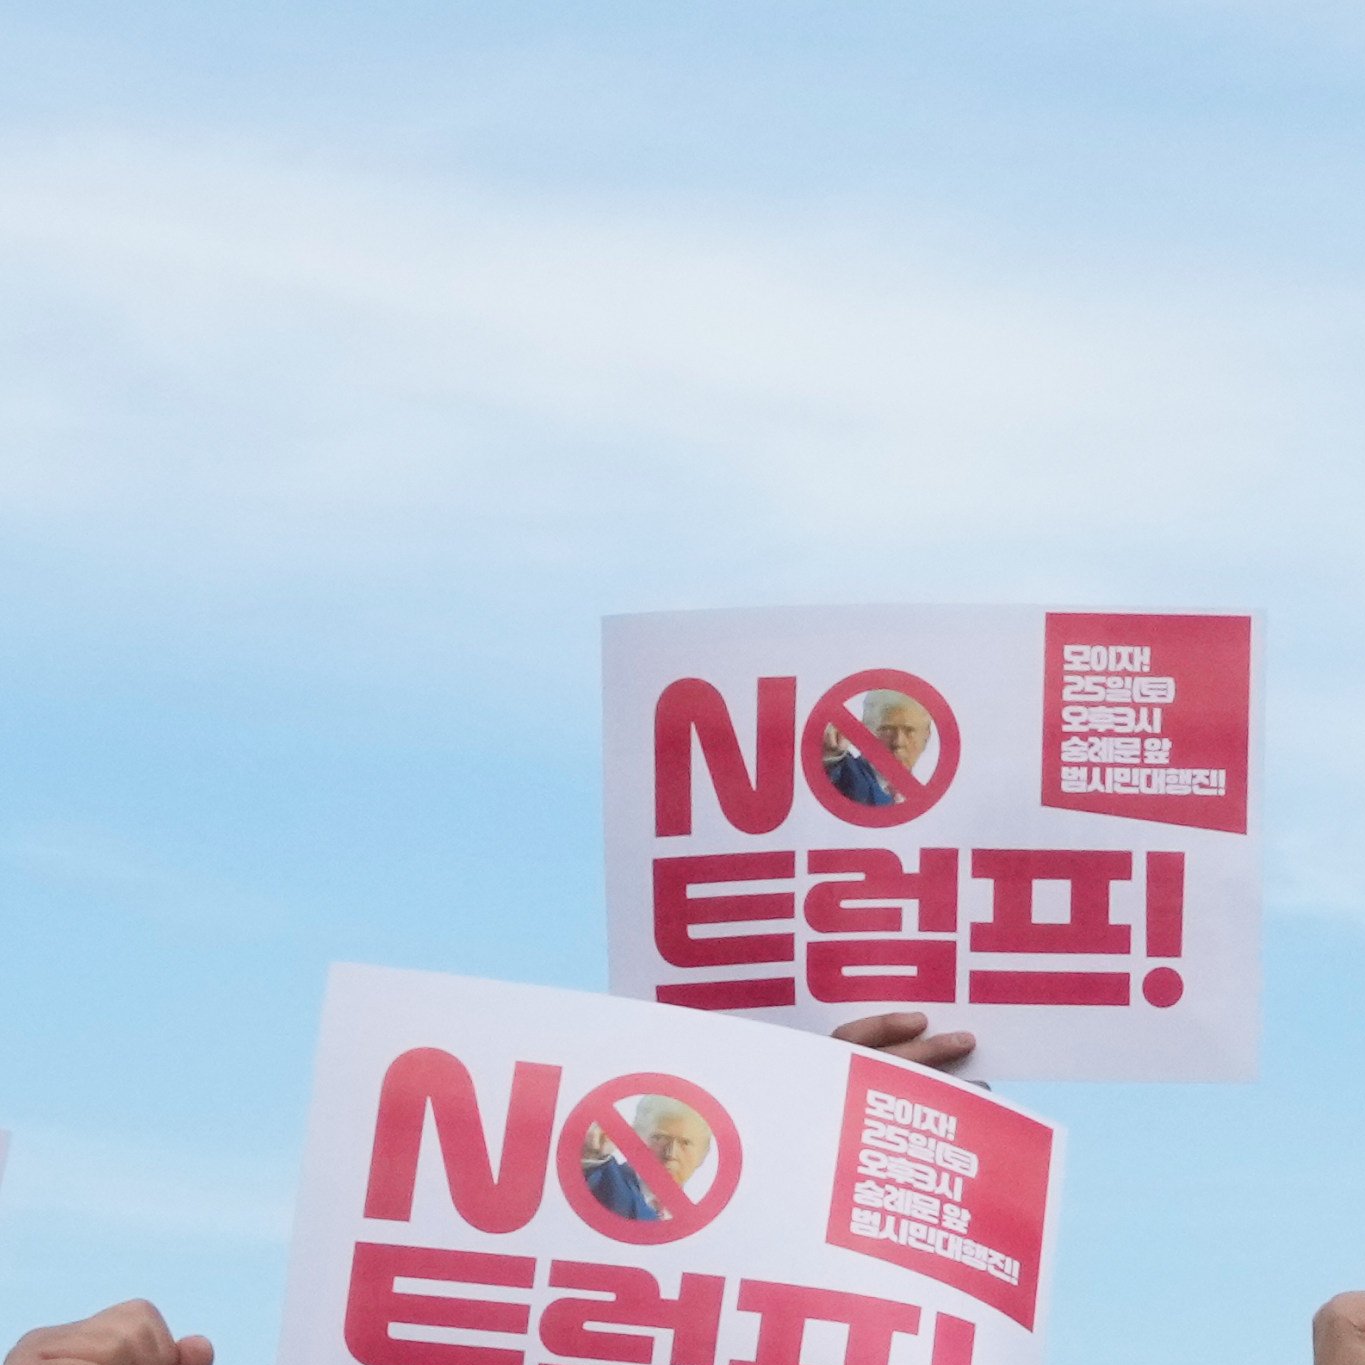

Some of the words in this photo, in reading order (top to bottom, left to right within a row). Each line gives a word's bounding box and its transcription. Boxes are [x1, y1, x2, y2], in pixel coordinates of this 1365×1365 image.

[1064, 645, 1150, 672] 모이자!
[1062, 675, 1176, 704] 25일(토)
[654, 668, 961, 837] NO
[1061, 737, 1142, 764] 숭례문
[1144, 738, 1171, 764] 앞
[1061, 767, 1226, 795] 범시민대행진!
[652, 848, 1185, 1010] 트럼프!
[865, 1090, 957, 1140] 모이자!
[364, 1047, 743, 1246] NO
[861, 1119, 978, 1178] 25일(토)
[854, 1180, 941, 1223] 숭례문
[943, 1204, 970, 1233] 앞
[850, 1208, 1020, 1284] 범시민대행진!
